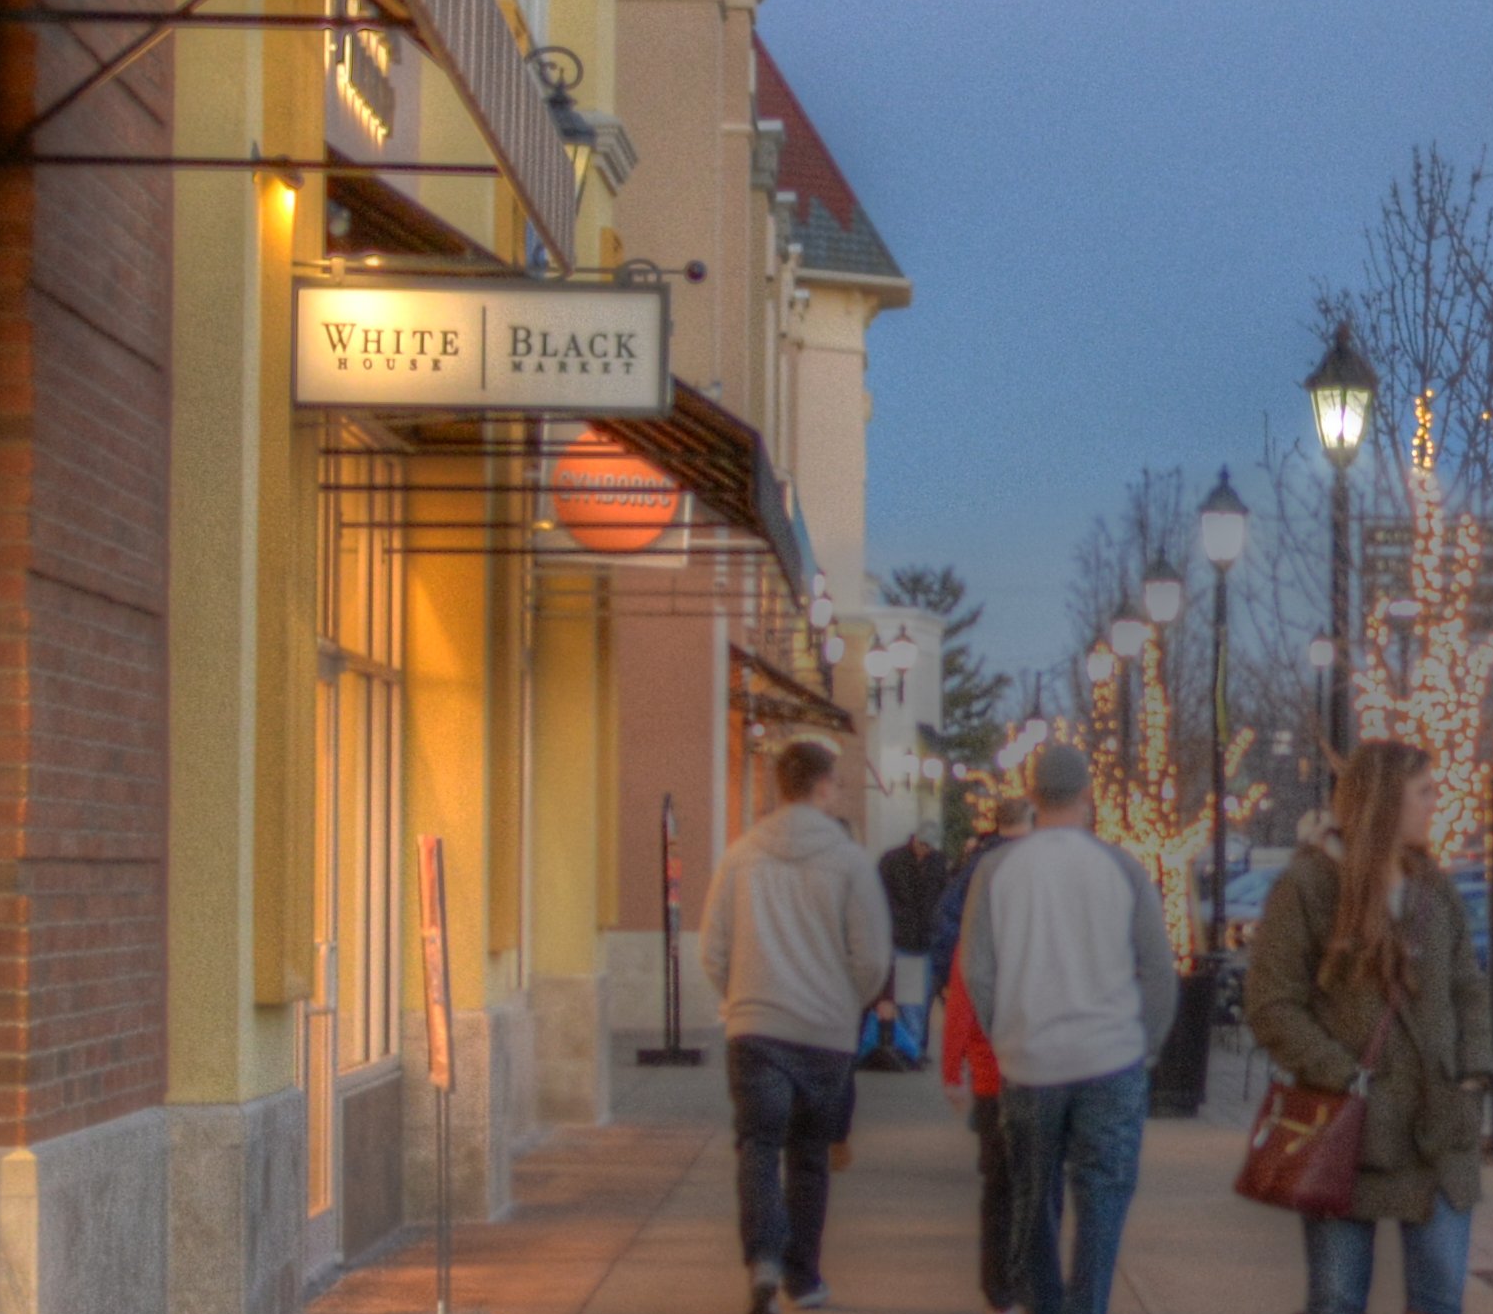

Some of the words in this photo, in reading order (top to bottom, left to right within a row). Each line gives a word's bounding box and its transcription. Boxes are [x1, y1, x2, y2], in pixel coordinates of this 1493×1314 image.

[322, 323, 460, 356] WHITE
[509, 326, 637, 359] BLACK
[337, 357, 443, 371] HOUSE
[510, 361, 636, 375] MARKET
